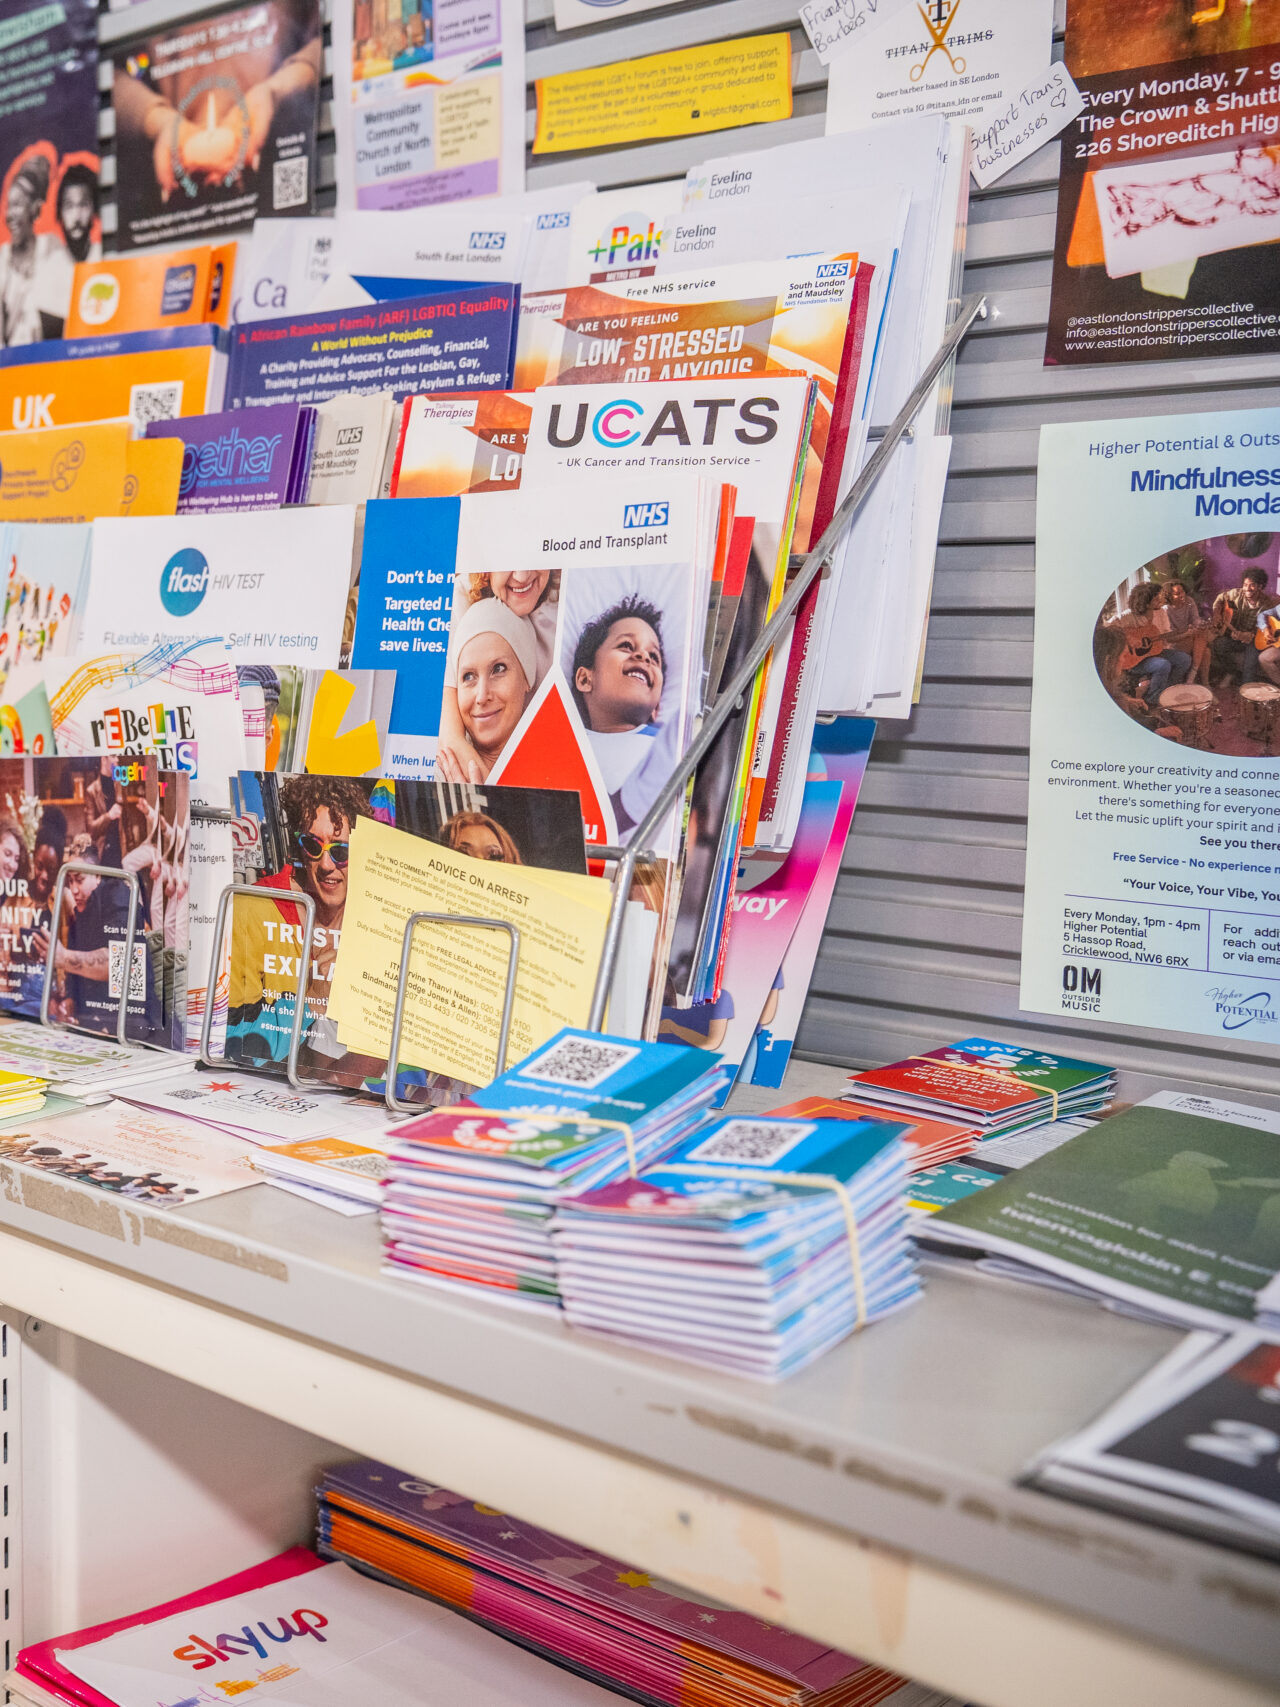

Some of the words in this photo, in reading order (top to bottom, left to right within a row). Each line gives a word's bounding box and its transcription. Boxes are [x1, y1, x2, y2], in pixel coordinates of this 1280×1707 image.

[885, 42, 929, 59] TITAN
[947, 30, 995, 47] TRIMS
[876, 89, 897, 100] Queer
[899, 85, 924, 96] barber
[925, 81, 948, 92] based
[971, 72, 1000, 83] London
[1020, 74, 1064, 107] Trans
[1079, 88, 1134, 108] Every
[1139, 72, 1229, 99] Monday,
[1235, 67, 1249, 86] 7
[364, 103, 422, 126] Metropolitan
[871, 108, 901, 120] Contact
[981, 91, 1003, 102] email
[1076, 116, 1115, 133] The
[1120, 104, 1188, 126] Crown
[1194, 98, 1209, 115] &
[367, 122, 419, 142] Community
[977, 113, 1048, 170] businesses
[1075, 138, 1112, 158] 226
[1117, 119, 1234, 152] Shoreditch
[356, 144, 390, 162] Church
[405, 136, 431, 151] North
[710, 169, 752, 186] Evelina
[708, 182, 751, 200] London
[536, 212, 570, 230] NHS
[675, 223, 717, 239] Evelina
[470, 232, 505, 250] NHS
[673, 236, 715, 253] London
[415, 250, 441, 262] South
[444, 251, 464, 263] East
[466, 252, 502, 264] London
[817, 262, 848, 278] NHS
[626, 287, 648, 297] Free
[652, 283, 674, 294] NHS
[677, 278, 716, 291] service
[787, 290, 805, 300] and
[807, 286, 845, 299] Maudsley
[789, 281, 814, 291] South
[815, 278, 846, 289] London
[339, 314, 377, 330] Family
[413, 303, 456, 322] LGBTIQ
[459, 296, 509, 316] Equality
[576, 320, 601, 333] ARE
[603, 317, 627, 330] YOU
[630, 312, 679, 327] FEELING
[1067, 301, 1254, 328] @eastlondonstripperscollective
[389, 328, 433, 343] Prejudice
[444, 337, 489, 353] Financial,
[575, 339, 625, 368] LOW,
[634, 325, 745, 362] STRESSED
[13, 393, 56, 430] UK
[423, 406, 474, 419] Therapies
[547, 397, 780, 449] UCATS
[336, 426, 363, 446] NHS
[1089, 442, 1140, 459] Higher
[1145, 434, 1219, 453] Potential
[1223, 434, 1235, 448] &
[566, 457, 581, 468] UK
[584, 456, 622, 468] Cancer
[625, 456, 646, 467] and
[650, 455, 705, 466] Transition
[710, 455, 750, 466] Service
[624, 502, 669, 528] NHS
[542, 538, 576, 552] Blood
[579, 537, 602, 550] and
[606, 533, 668, 550] Transplant
[167, 566, 209, 594] flash
[213, 574, 235, 590] HIV
[238, 572, 265, 590] TEST
[386, 570, 424, 585] Don't
[427, 570, 444, 584] be
[384, 597, 442, 614] Targeted
[382, 617, 425, 632] Health
[279, 633, 319, 651] testing
[379, 640, 410, 652] save
[412, 637, 446, 653] lives.
[392, 755, 419, 767] When
[1050, 759, 1082, 771] Come
[1084, 761, 1125, 775] explore
[1128, 764, 1155, 776] your
[1156, 763, 1212, 779] creativity
[1215, 768, 1238, 779] and
[1048, 777, 1120, 789] environment.
[1123, 780, 1172, 793] Whether
[1175, 783, 1212, 796] you're
[1098, 795, 1137, 808] there's
[1140, 798, 1201, 813] something
[1203, 800, 1221, 812] for
[1075, 810, 1093, 821] Let
[1095, 811, 1114, 822] the
[1116, 814, 1150, 825] music
[1152, 815, 1183, 828] uplift
[1185, 818, 1213, 830] your
[1216, 819, 1248, 833] spirit
[1250, 822, 1274, 833] and
[1200, 835, 1222, 848] See
[1225, 838, 1247, 850] you
[1113, 852, 1136, 863] Free
[1138, 854, 1180, 867] Service
[1189, 858, 1205, 868] No
[1208, 860, 1272, 875] experience
[427, 858, 467, 881] ADVICE
[469, 874, 485, 889] ON
[486, 882, 530, 907] ARREST
[1158, 882, 1194, 896] Voice,
[1197, 885, 1225, 898] Your
[1227, 888, 1258, 902] Vibe,
[1063, 920, 1098, 934] Higher
[1100, 924, 1148, 939] Potential
[1064, 908, 1092, 921] Every
[1095, 911, 1141, 926] Monday,
[1143, 917, 1166, 929] 1pm
[1175, 920, 1201, 933] 4pm
[1223, 923, 1243, 935] For
[1063, 932, 1070, 941] 5
[1072, 933, 1113, 948] Hassop
[1115, 938, 1146, 951] Road,
[1223, 937, 1256, 949] reach
[1062, 944, 1132, 962] Cricklewood,
[1135, 952, 1163, 964] NW6
[1166, 955, 1189, 967] 6RX
[1238, 952, 1254, 963] via
[428, 978, 452, 995] Thanvi
[1063, 965, 1102, 995] OM
[262, 988, 282, 1000] Skip
[427, 990, 449, 1006] Jones
[1062, 1000, 1101, 1013] MUSIC
[1215, 1002, 1279, 1021] POTENTIAL
[964, 1046, 1034, 1057] WAYS
[976, 1052, 1023, 1068] 5
